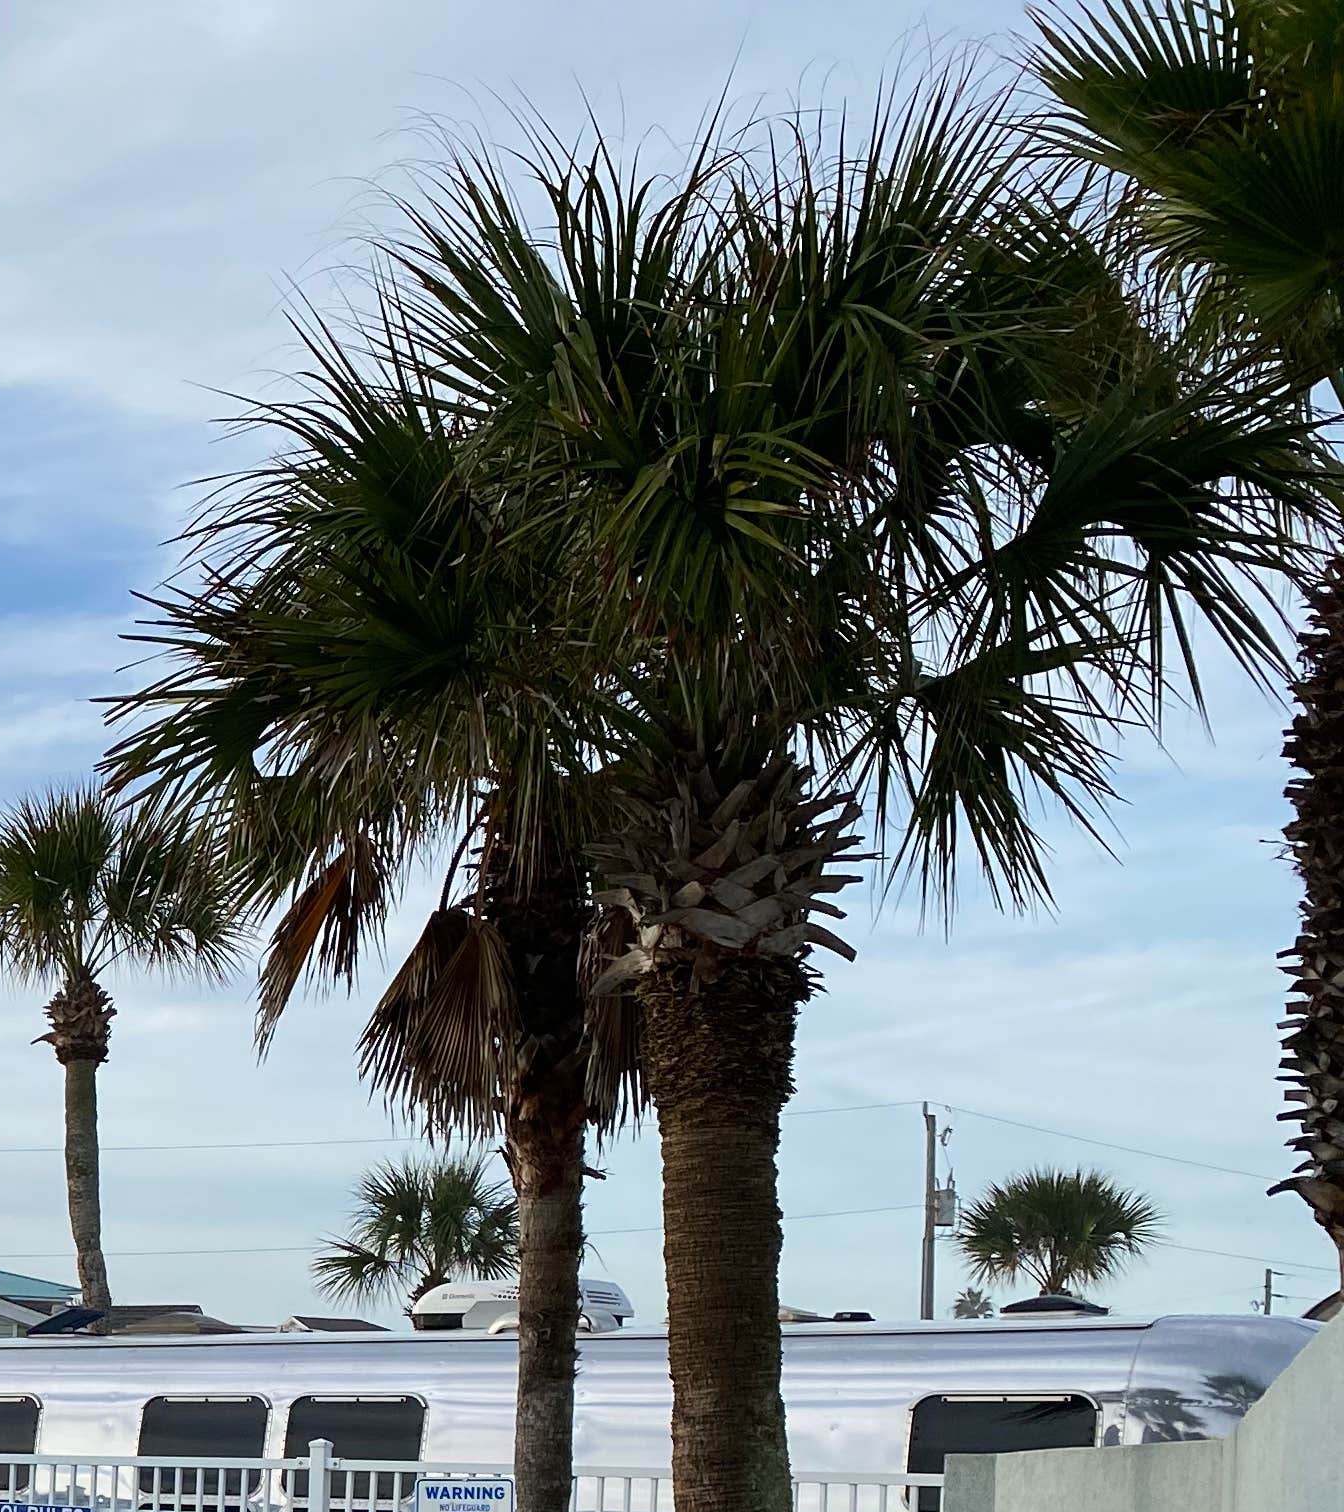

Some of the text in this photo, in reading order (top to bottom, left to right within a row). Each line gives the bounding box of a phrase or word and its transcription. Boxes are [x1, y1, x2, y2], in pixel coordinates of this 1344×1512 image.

[425, 1486, 505, 1500] WARNING
[439, 1504, 491, 1512] NO LIFEGUARD
